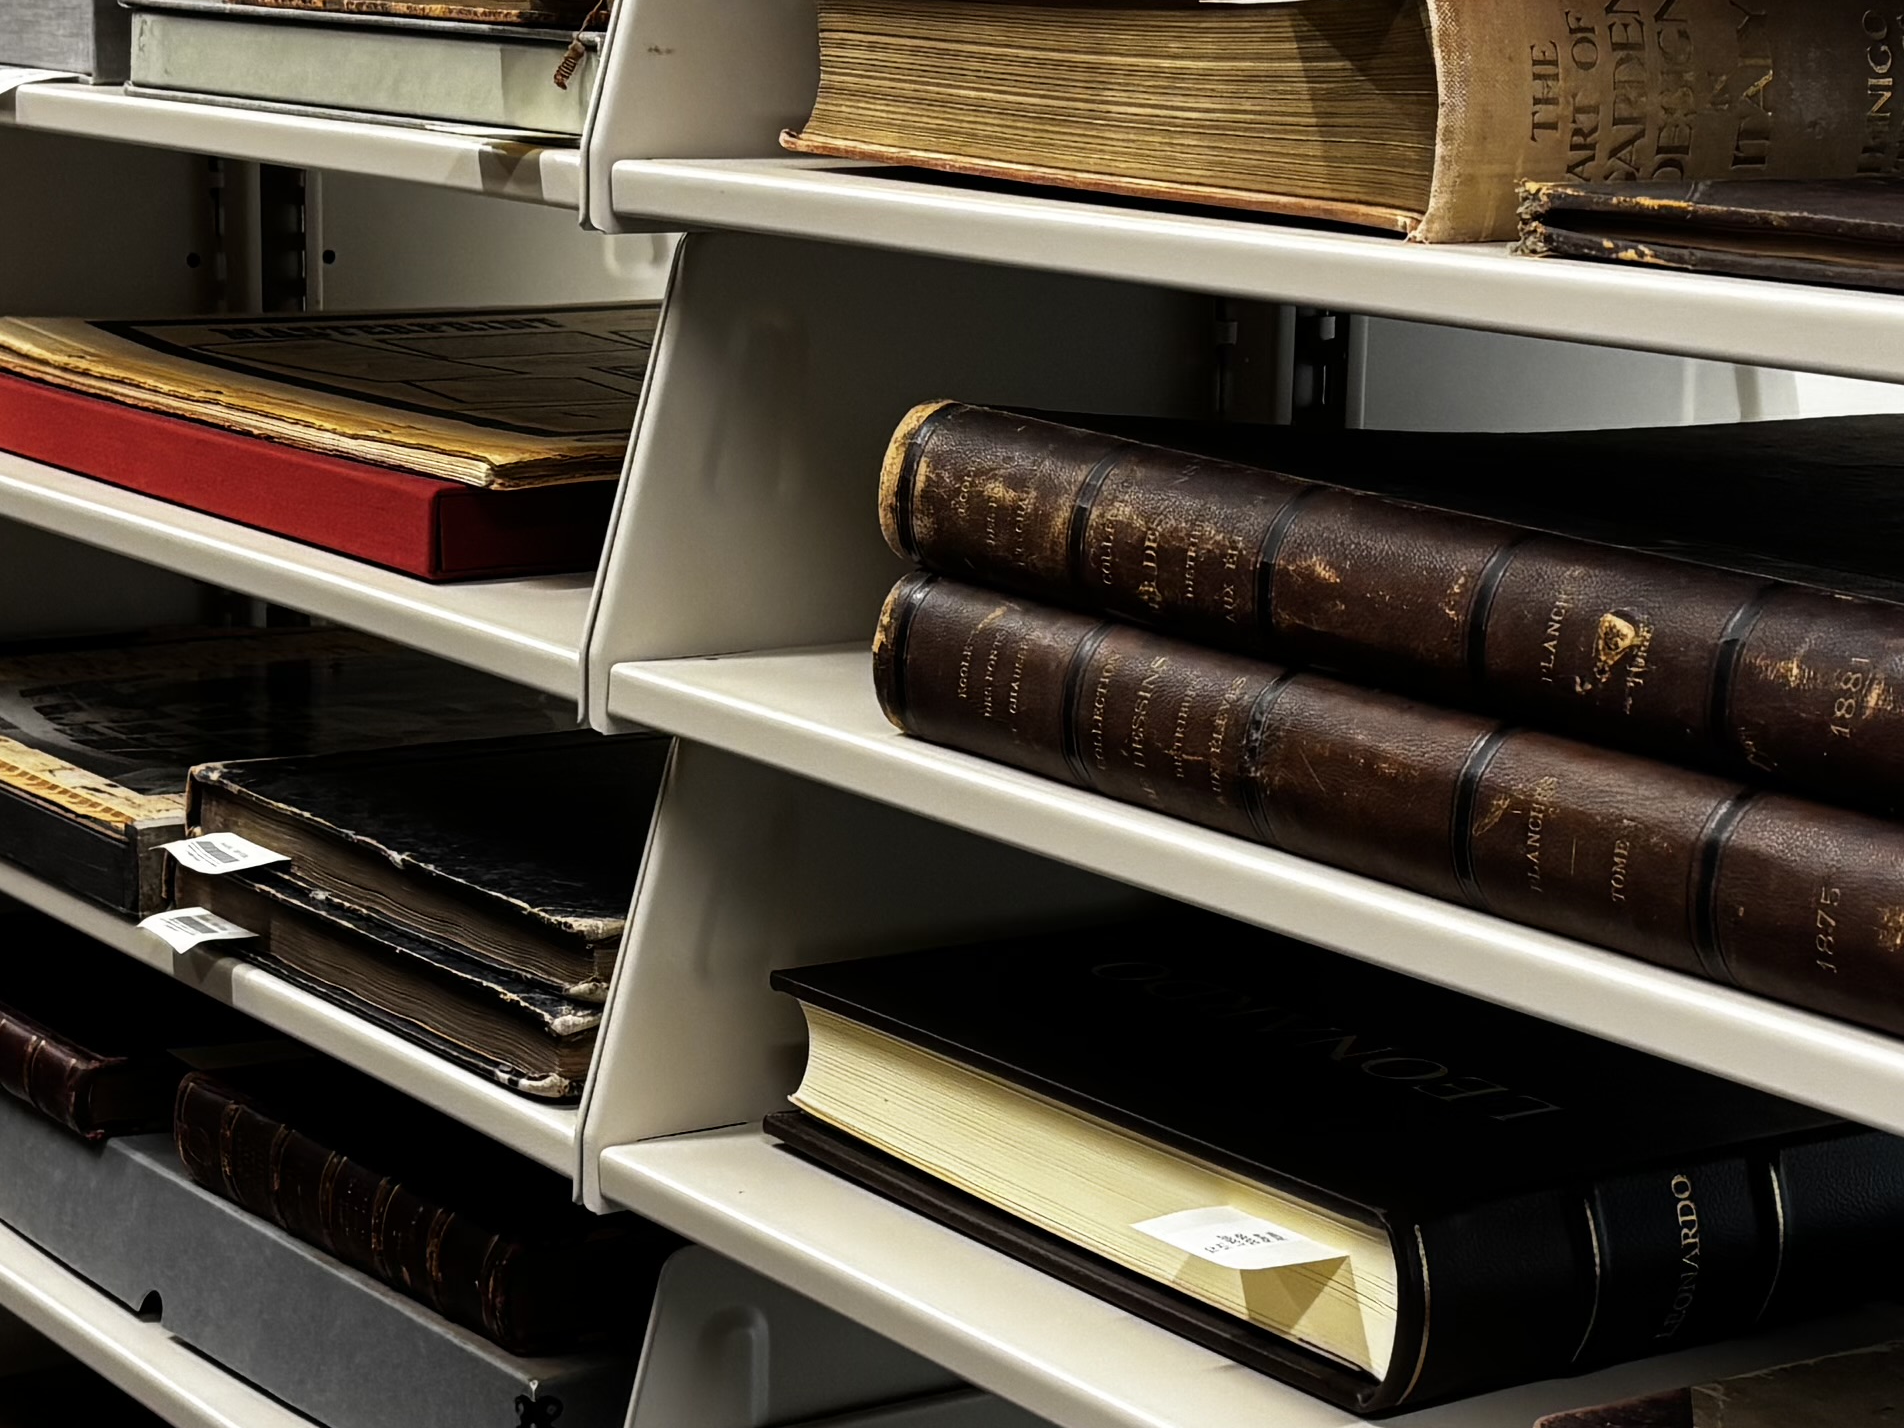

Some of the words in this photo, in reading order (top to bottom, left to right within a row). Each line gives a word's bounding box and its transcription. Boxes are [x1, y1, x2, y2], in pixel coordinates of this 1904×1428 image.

[1565, 9, 1599, 71] OF
[1530, 39, 1560, 142] THE
[1566, 93, 1599, 181] ART
[1831, 657, 1871, 738] 1881
[1610, 839, 1631, 904] TOME
[1816, 885, 1841, 974] 1875
[1655, 1174, 1701, 1340] LEONARDO
